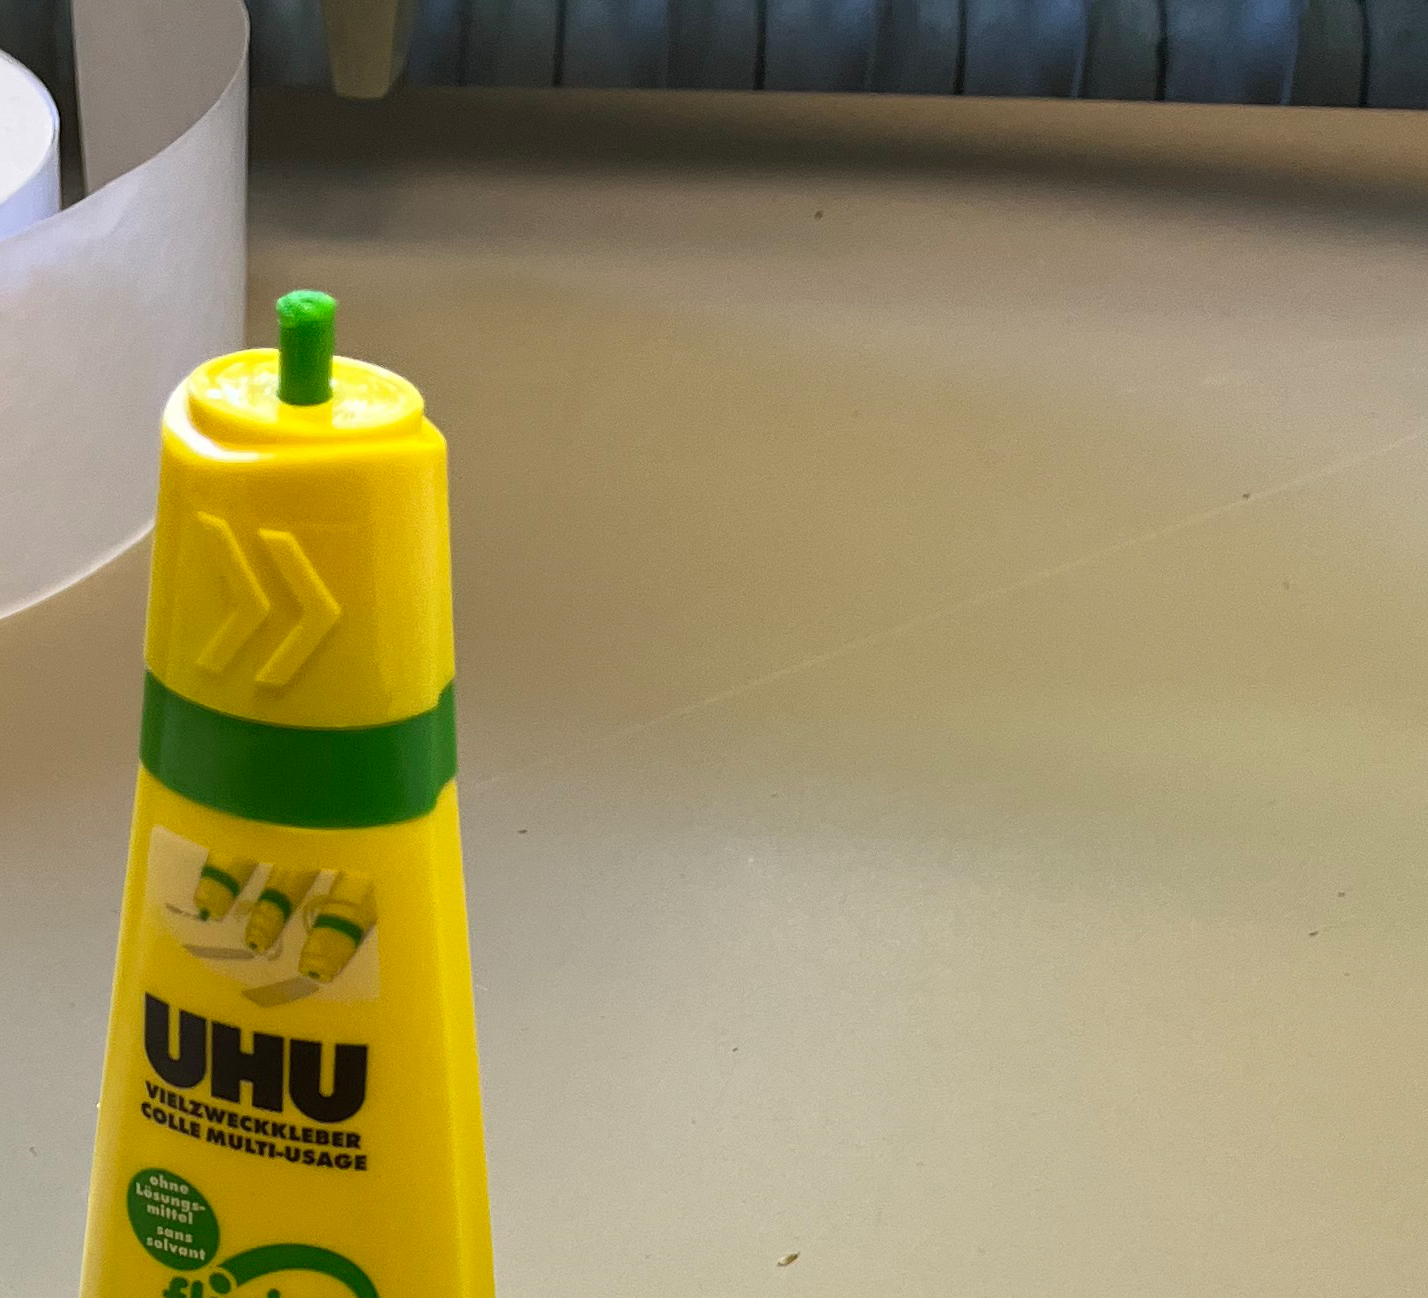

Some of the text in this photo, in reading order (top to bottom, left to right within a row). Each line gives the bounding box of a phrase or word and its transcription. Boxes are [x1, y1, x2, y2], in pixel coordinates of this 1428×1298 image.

[144, 991, 369, 1124] UHU
[145, 1080, 362, 1150] VIELZWECKKLEBER
[140, 1102, 368, 1171] COLLE MULTI-USAGE
[135, 1182, 206, 1212] Lösungs-
[149, 1174, 189, 1195] ohne
[147, 1204, 194, 1225] mittel
[156, 1226, 193, 1243] sans
[146, 1237, 206, 1261] solvant
